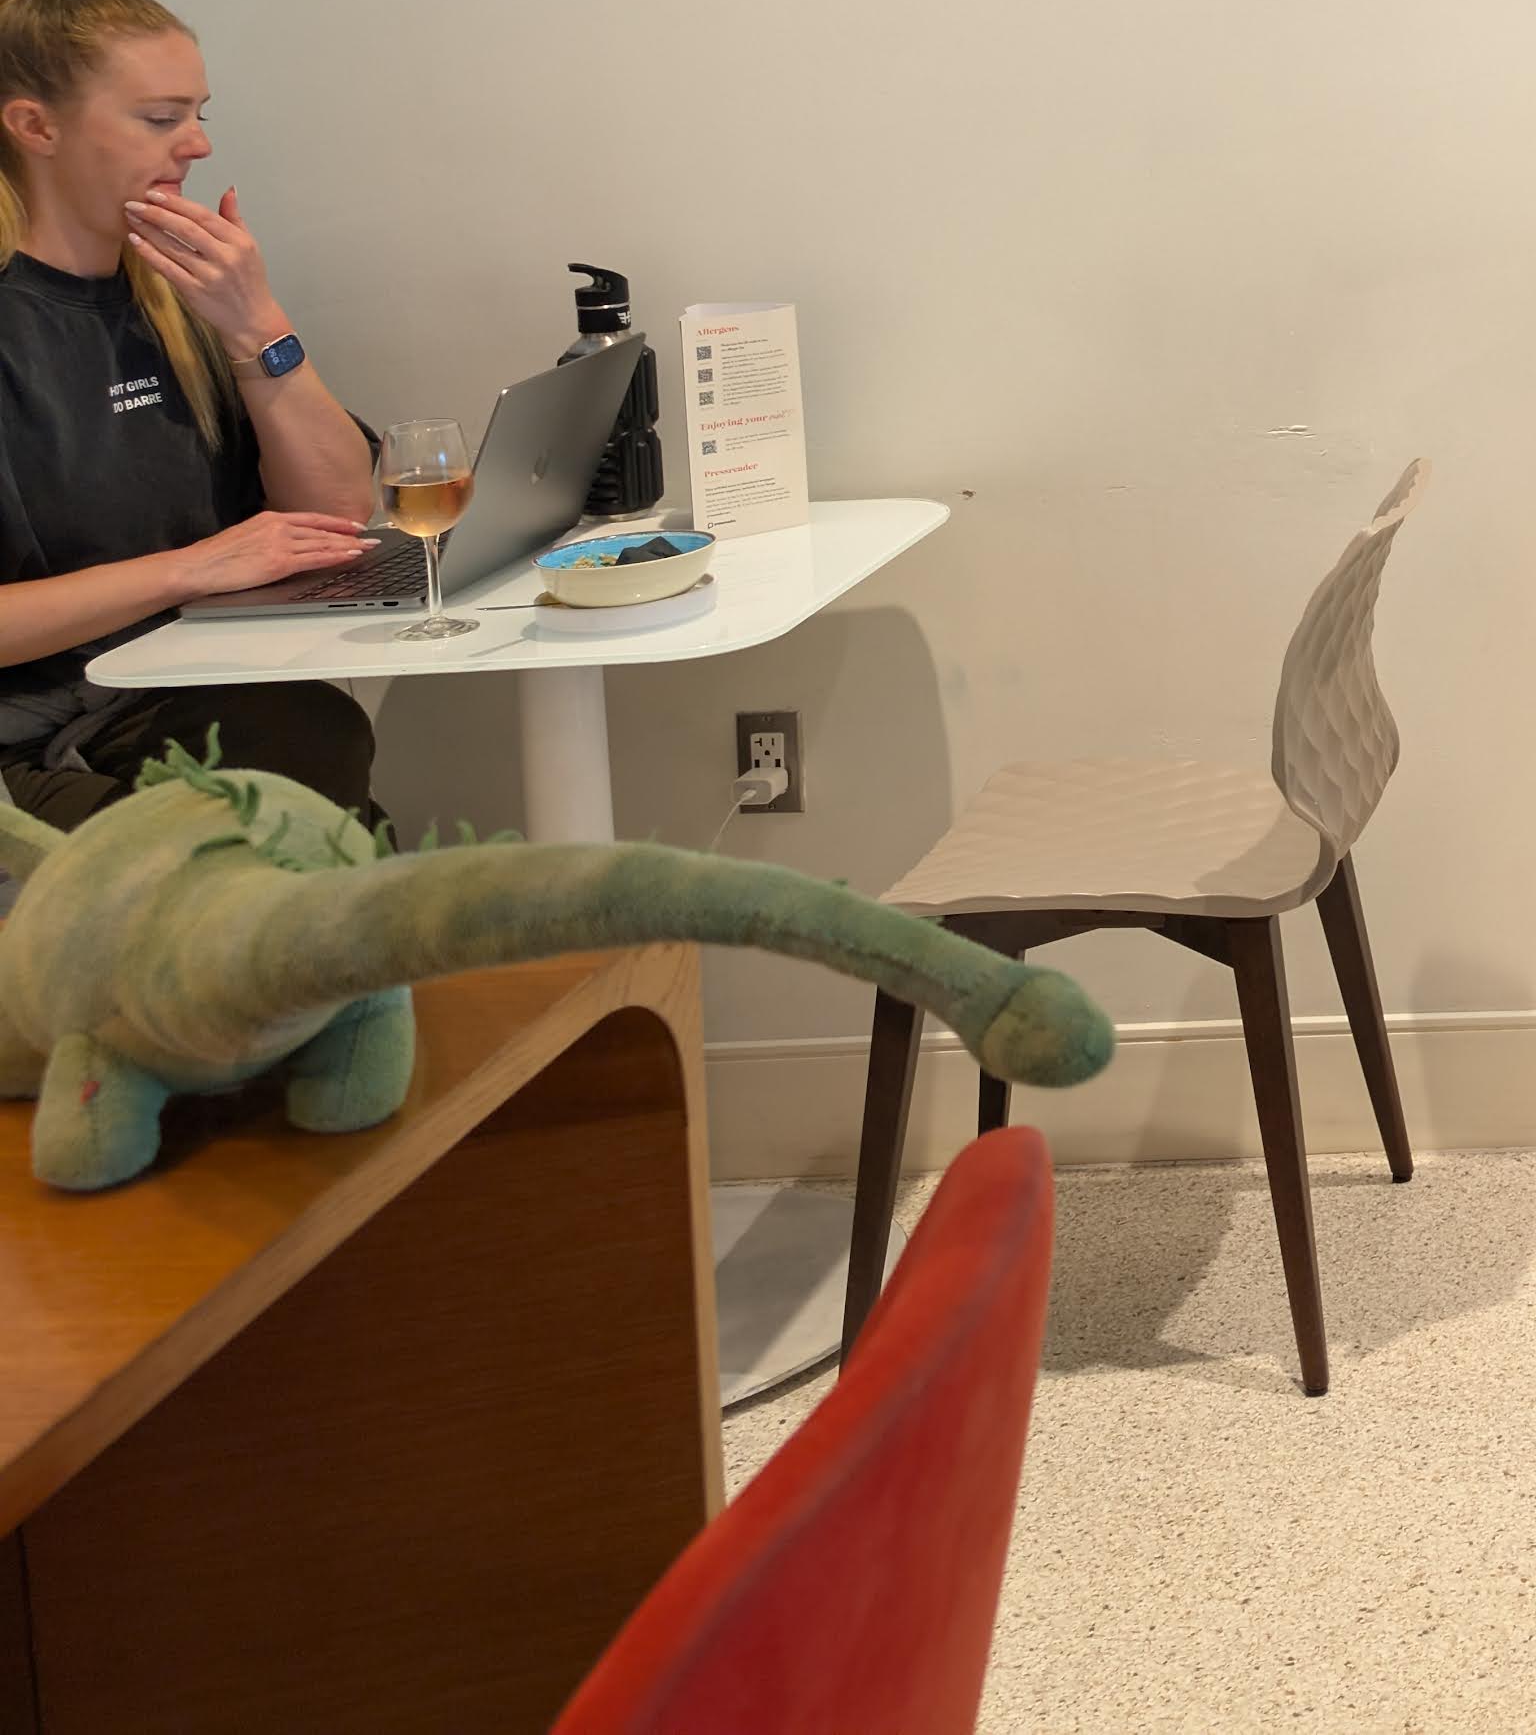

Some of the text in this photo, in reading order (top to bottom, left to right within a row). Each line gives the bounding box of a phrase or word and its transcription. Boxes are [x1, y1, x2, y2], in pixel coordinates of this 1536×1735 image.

[696, 325, 740, 338] Allergens
[109, 376, 159, 397] HOT GIRLS
[113, 392, 163, 414] DO BARRE
[700, 417, 743, 432] Enjoying
[744, 415, 769, 426] your
[704, 462, 760, 478] Pressreader
